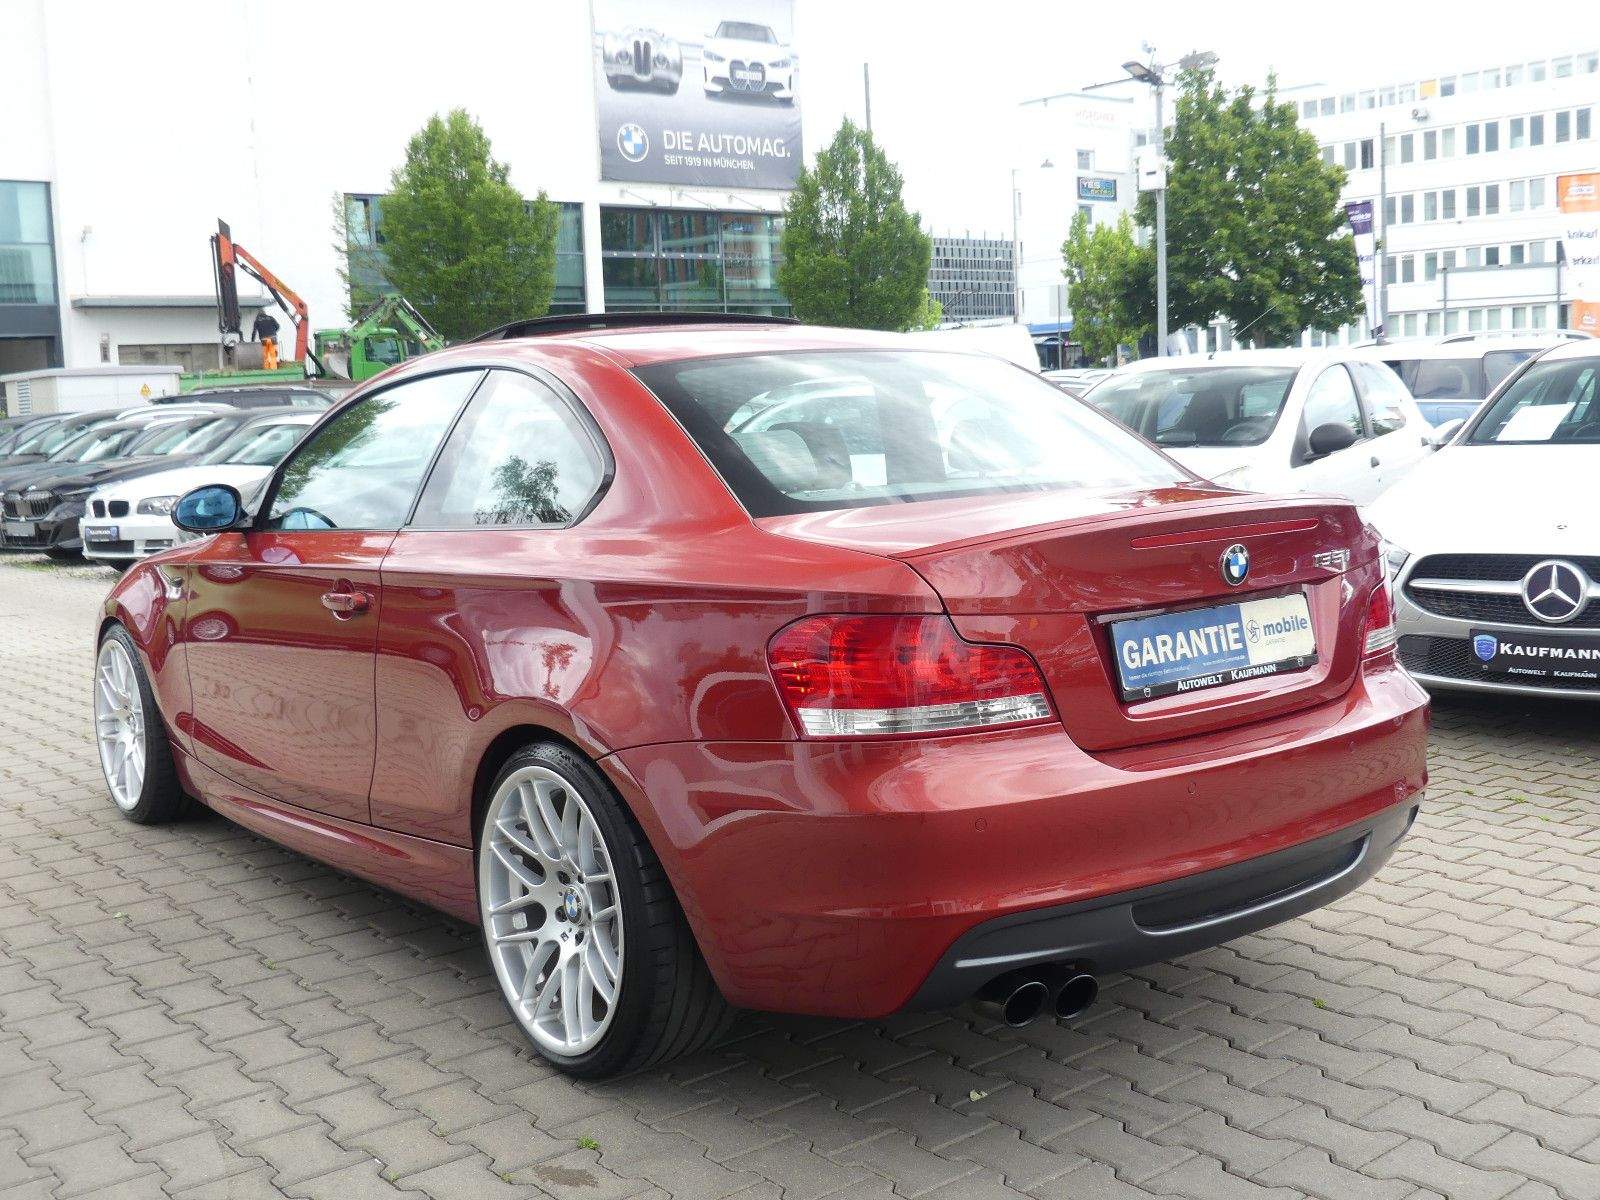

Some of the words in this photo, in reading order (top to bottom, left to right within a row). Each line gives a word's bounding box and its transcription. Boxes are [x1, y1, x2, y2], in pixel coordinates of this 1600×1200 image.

[662, 129, 694, 151] DIE
[697, 132, 791, 158] AUTOMAG.
[664, 154, 683, 166] SEIT
[684, 156, 702, 167] 1919
[702, 158, 712, 168] IN
[713, 156, 756, 171] MÜNCHEN.
[1122, 622, 1243, 669] GARANTIE
[1263, 614, 1308, 637] mobile
[1499, 642, 1600, 660] KAUFMANN
[1177, 673, 1223, 692] AUTOWELT
[1231, 664, 1277, 680] KAUFMANN
[1508, 666, 1547, 676] AUTOWELT
[1553, 670, 1598, 679] KAUFMANN
